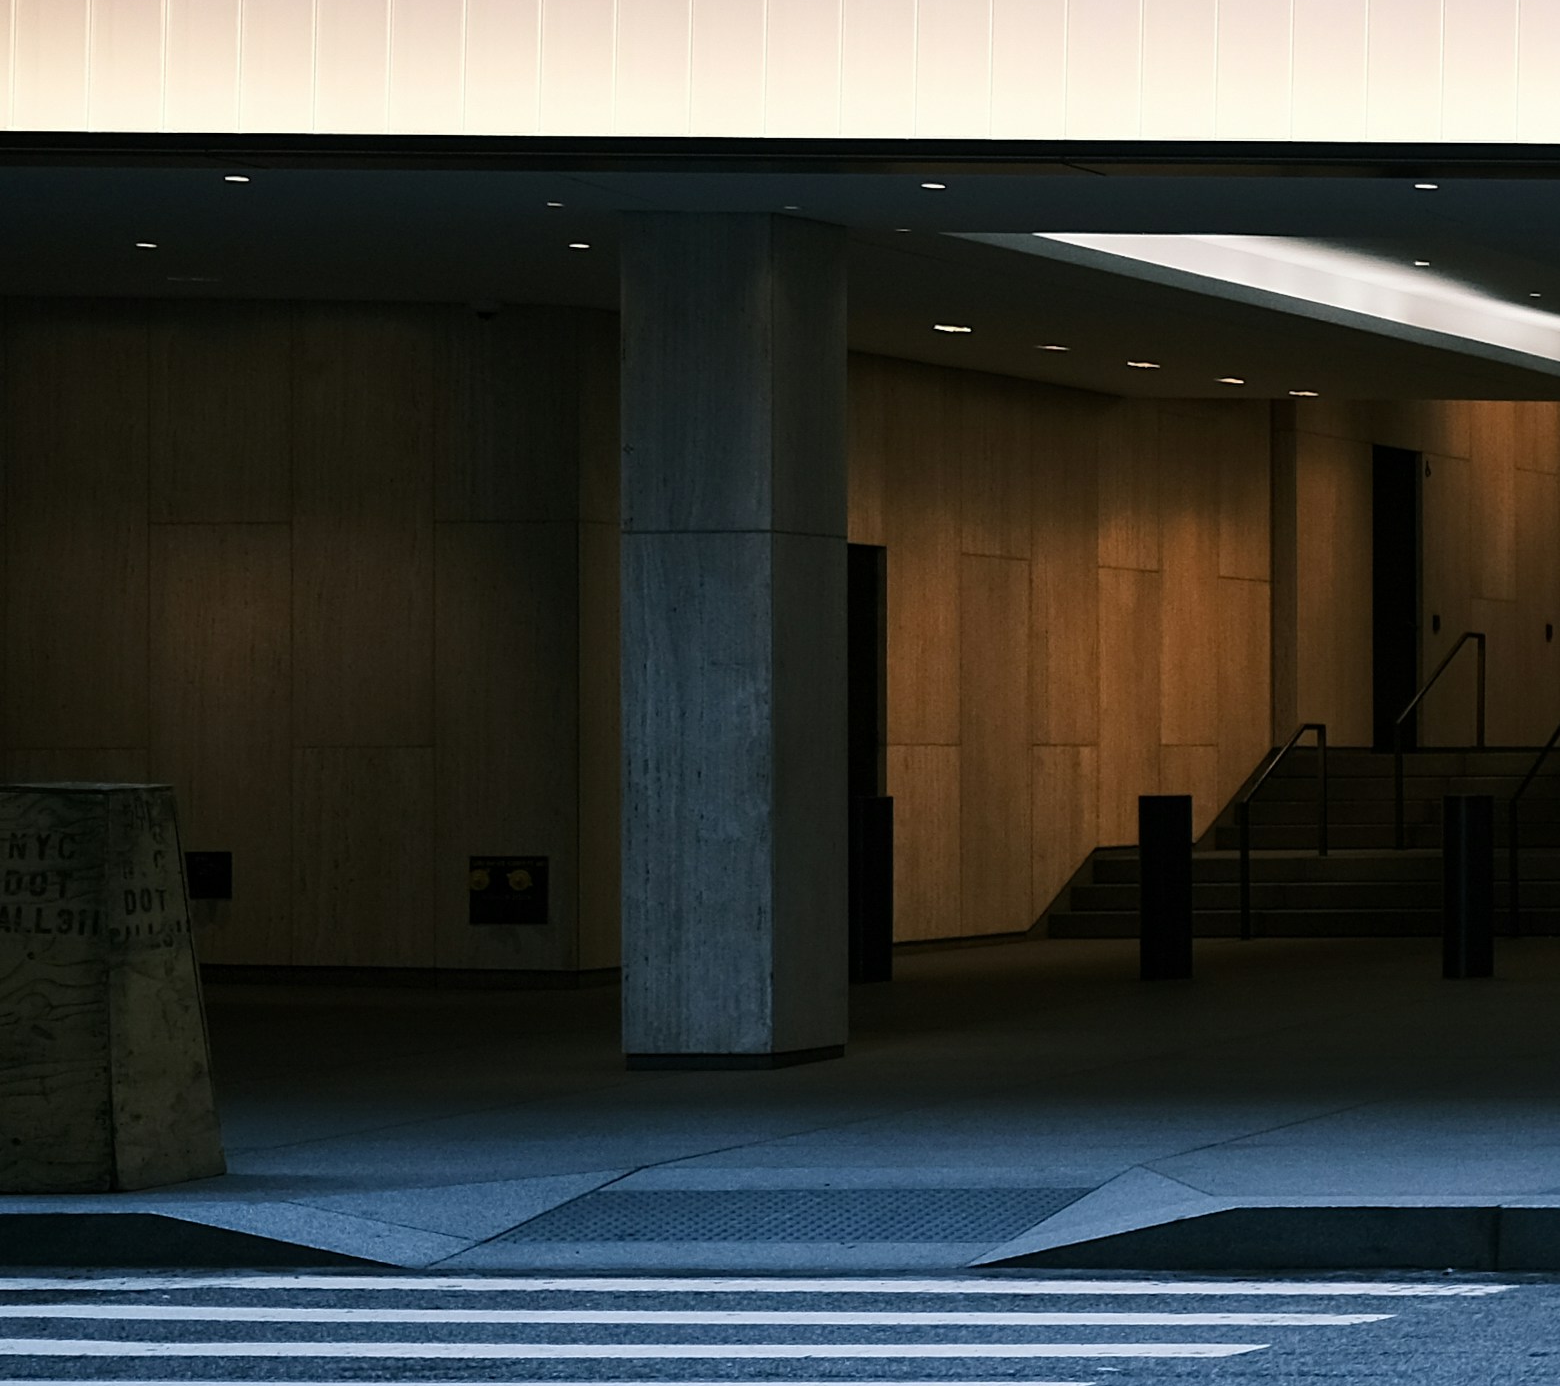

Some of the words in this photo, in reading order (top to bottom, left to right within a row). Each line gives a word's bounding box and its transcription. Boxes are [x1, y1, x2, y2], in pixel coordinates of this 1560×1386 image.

[8, 832, 76, 861] NYC
[4, 869, 73, 899] DOT
[123, 888, 166, 915] DOT
